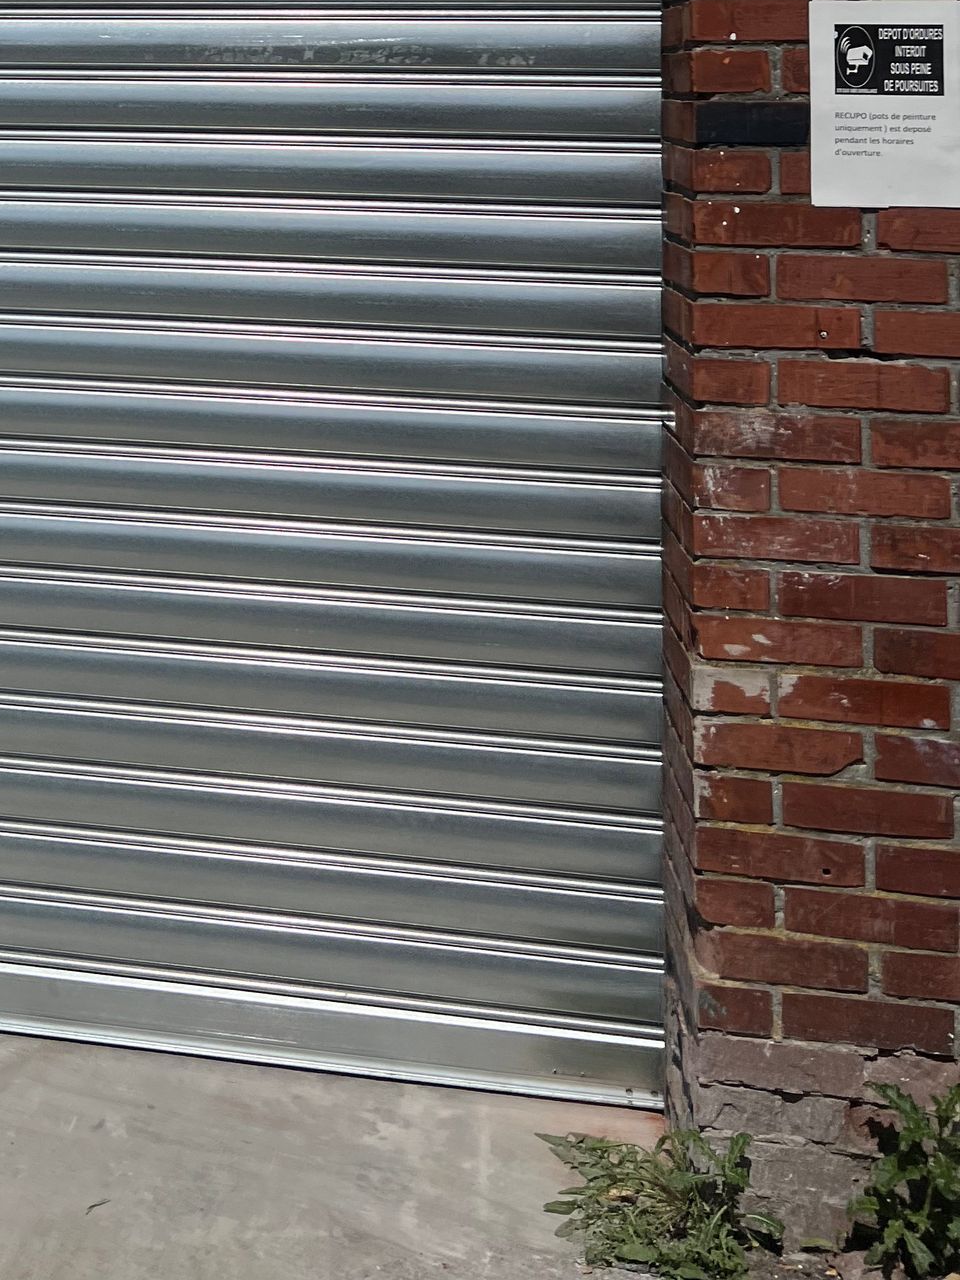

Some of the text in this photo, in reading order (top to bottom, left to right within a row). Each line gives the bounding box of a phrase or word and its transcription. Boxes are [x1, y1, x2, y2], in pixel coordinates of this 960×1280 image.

[878, 28, 943, 40] DEPOT D'ORDURES
[895, 45, 927, 57] INTERDIT
[890, 62, 932, 75] SOUS PEINE
[883, 80, 894, 92] DE
[895, 80, 939, 92] POURSUITES
[834, 111, 868, 120] RECUPO
[890, 112, 901, 120] de
[902, 113, 937, 121] peinture
[834, 124, 882, 132] uniquement
[889, 125, 902, 133] est
[834, 137, 915, 146] pendant les horaires
